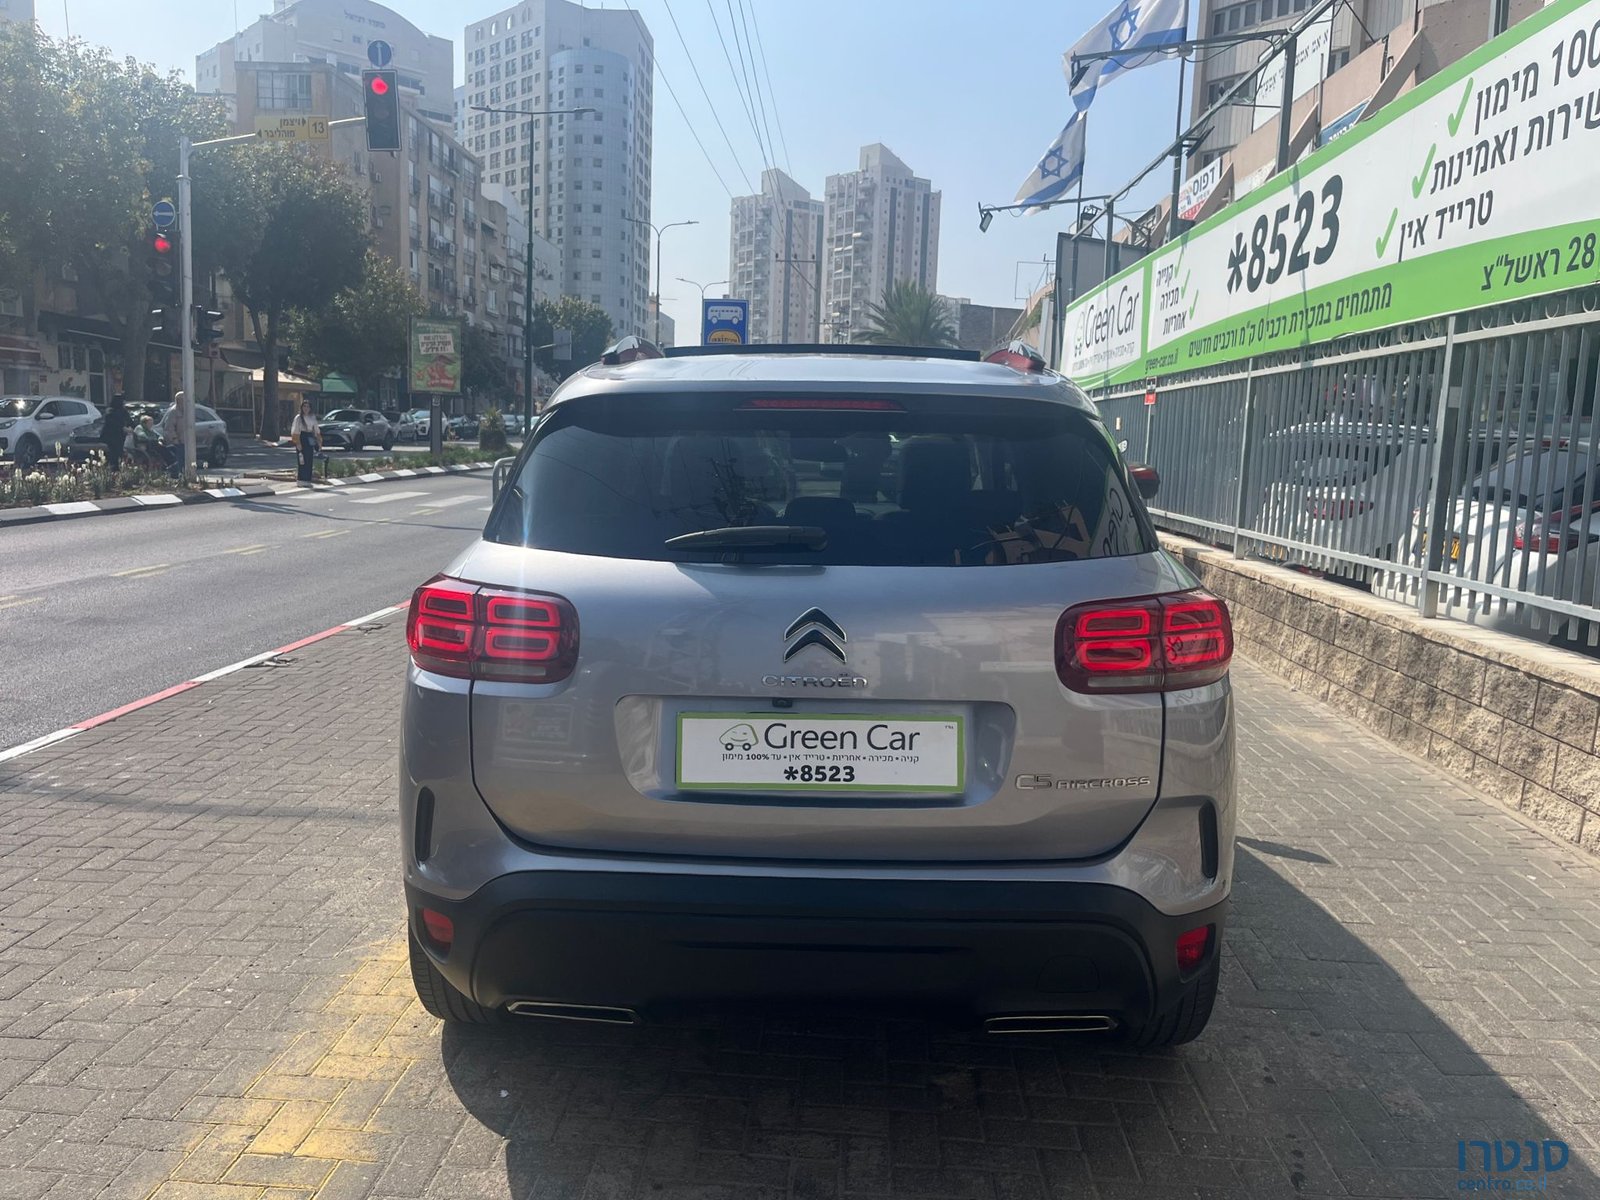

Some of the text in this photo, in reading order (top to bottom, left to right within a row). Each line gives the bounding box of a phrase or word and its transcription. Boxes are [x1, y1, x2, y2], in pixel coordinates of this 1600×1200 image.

[1474, 62, 1539, 136] מימון
[312, 122, 325, 135] 13
[1430, 126, 1519, 195] ואמינות
[1193, 167, 1215, 196] דפוס
[1398, 190, 1493, 262] טרייד אין
[1566, 232, 1597, 272] 28
[1160, 287, 1179, 311] מכירה
[1335, 282, 1392, 322] מתמחים
[1085, 285, 1140, 349] Green Car
[1288, 301, 1332, 334] במכירת
[1188, 336, 1212, 358] חדשים
[1213, 329, 1237, 352] ורכבים
[762, 673, 868, 688] CITROËN
[764, 723, 920, 751] Green Car
[722, 754, 743, 762] מימון
[789, 754, 800, 762] אין
[900, 755, 919, 764] קניה
[1015, 773, 1151, 790] C5 AIRCROSS
